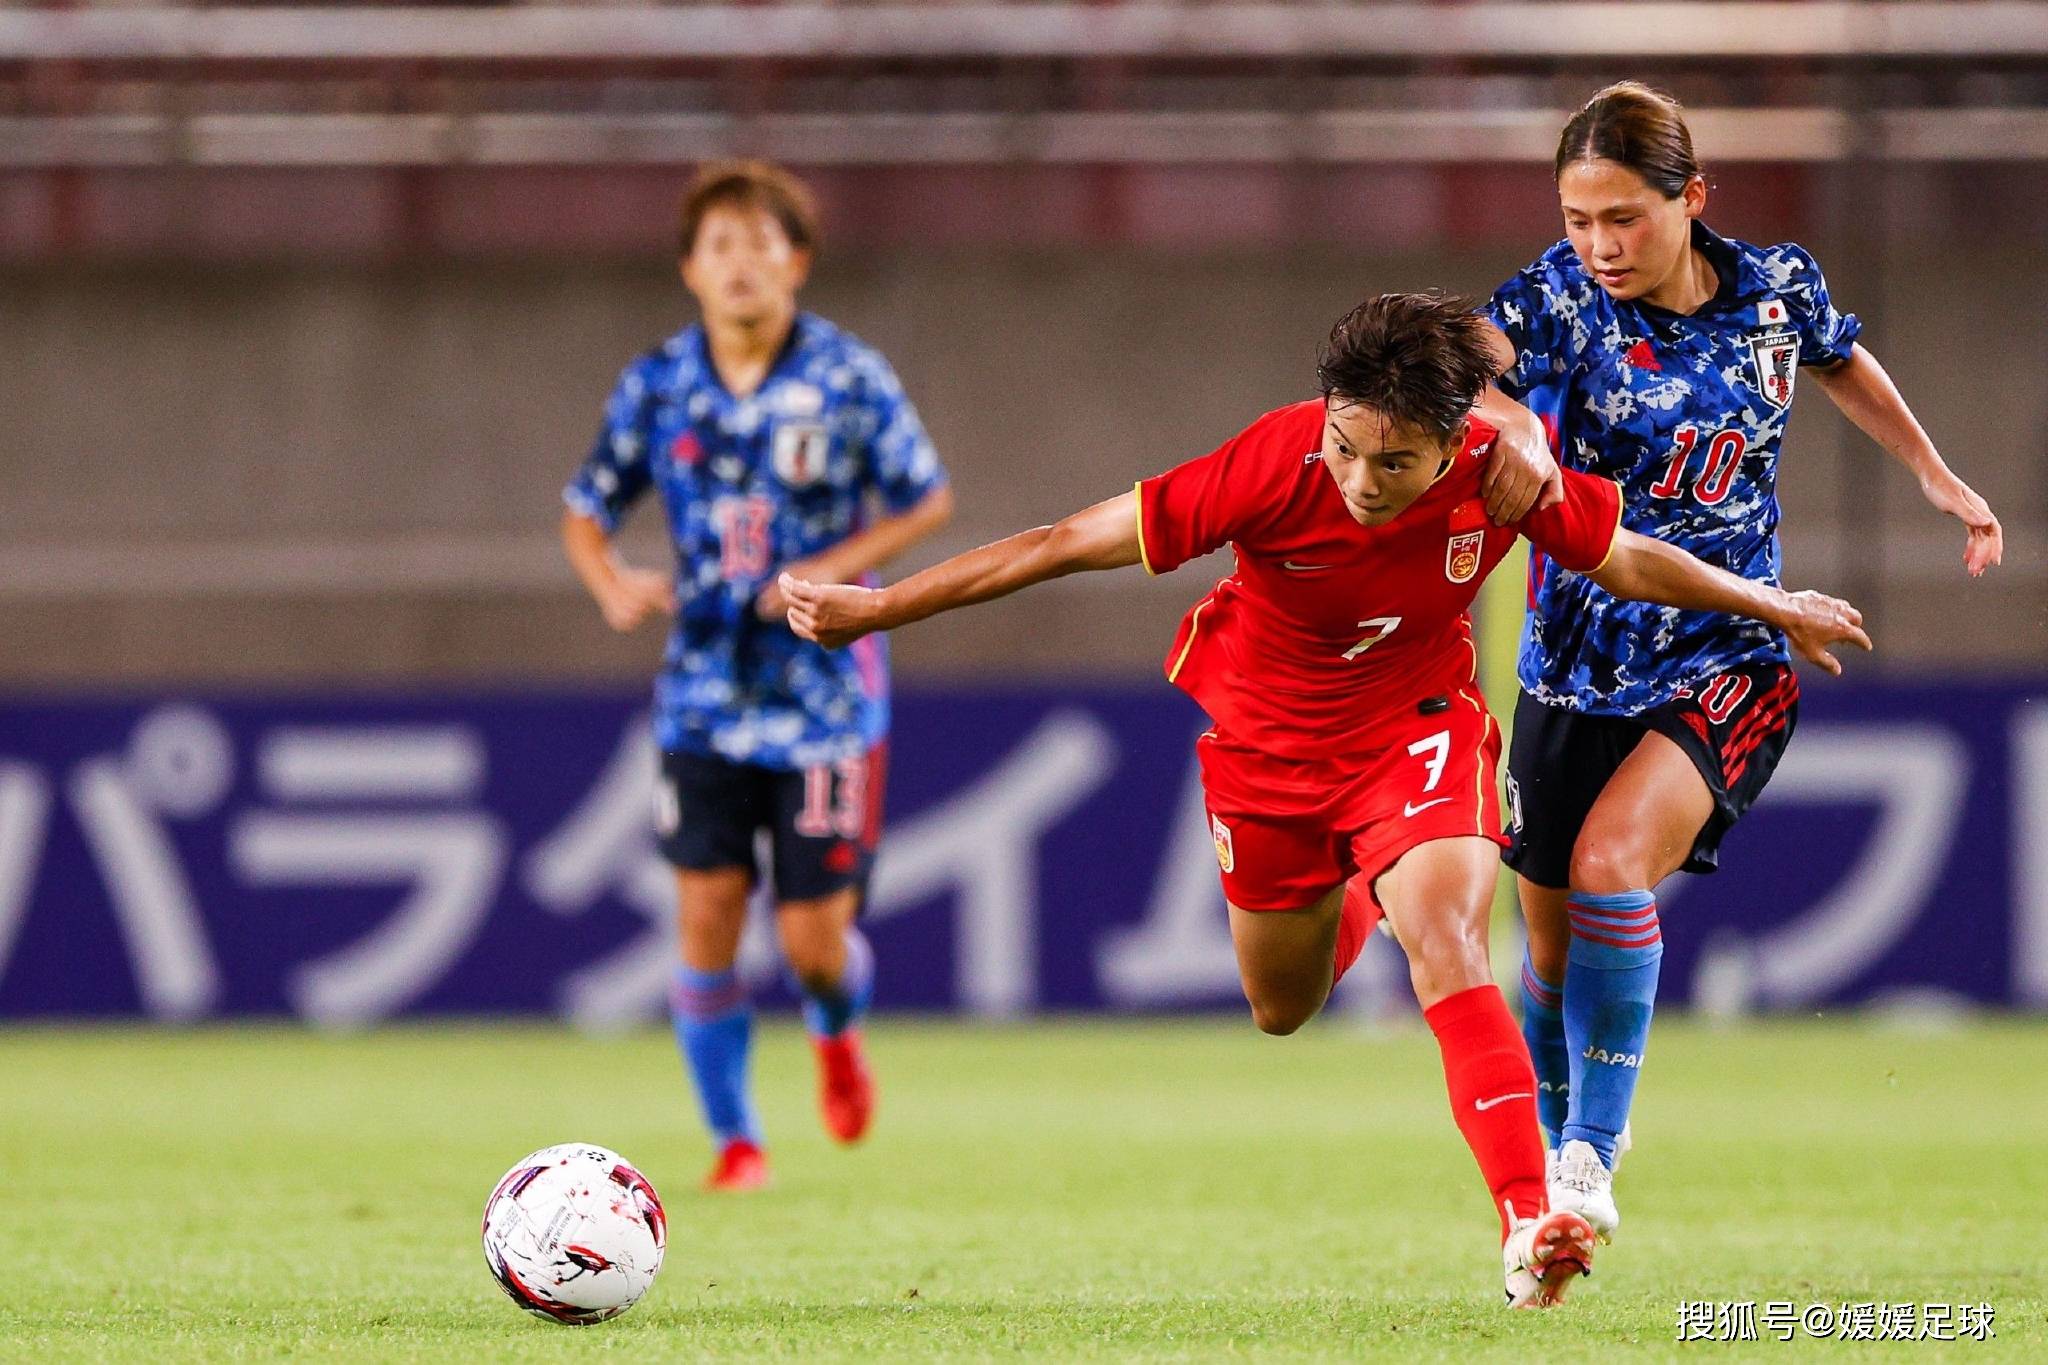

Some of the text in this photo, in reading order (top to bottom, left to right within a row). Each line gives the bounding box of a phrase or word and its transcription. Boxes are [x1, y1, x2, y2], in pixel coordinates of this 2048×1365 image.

[1764, 336, 1790, 347] JAPAN
[1649, 425, 1747, 506] 10
[720, 497, 776, 579] 13
[1453, 535, 1479, 549] CFA
[1340, 617, 1402, 661] 7
[1670, 674, 1753, 725] 0
[1407, 729, 1451, 793] 7
[795, 757, 870, 839] 13
